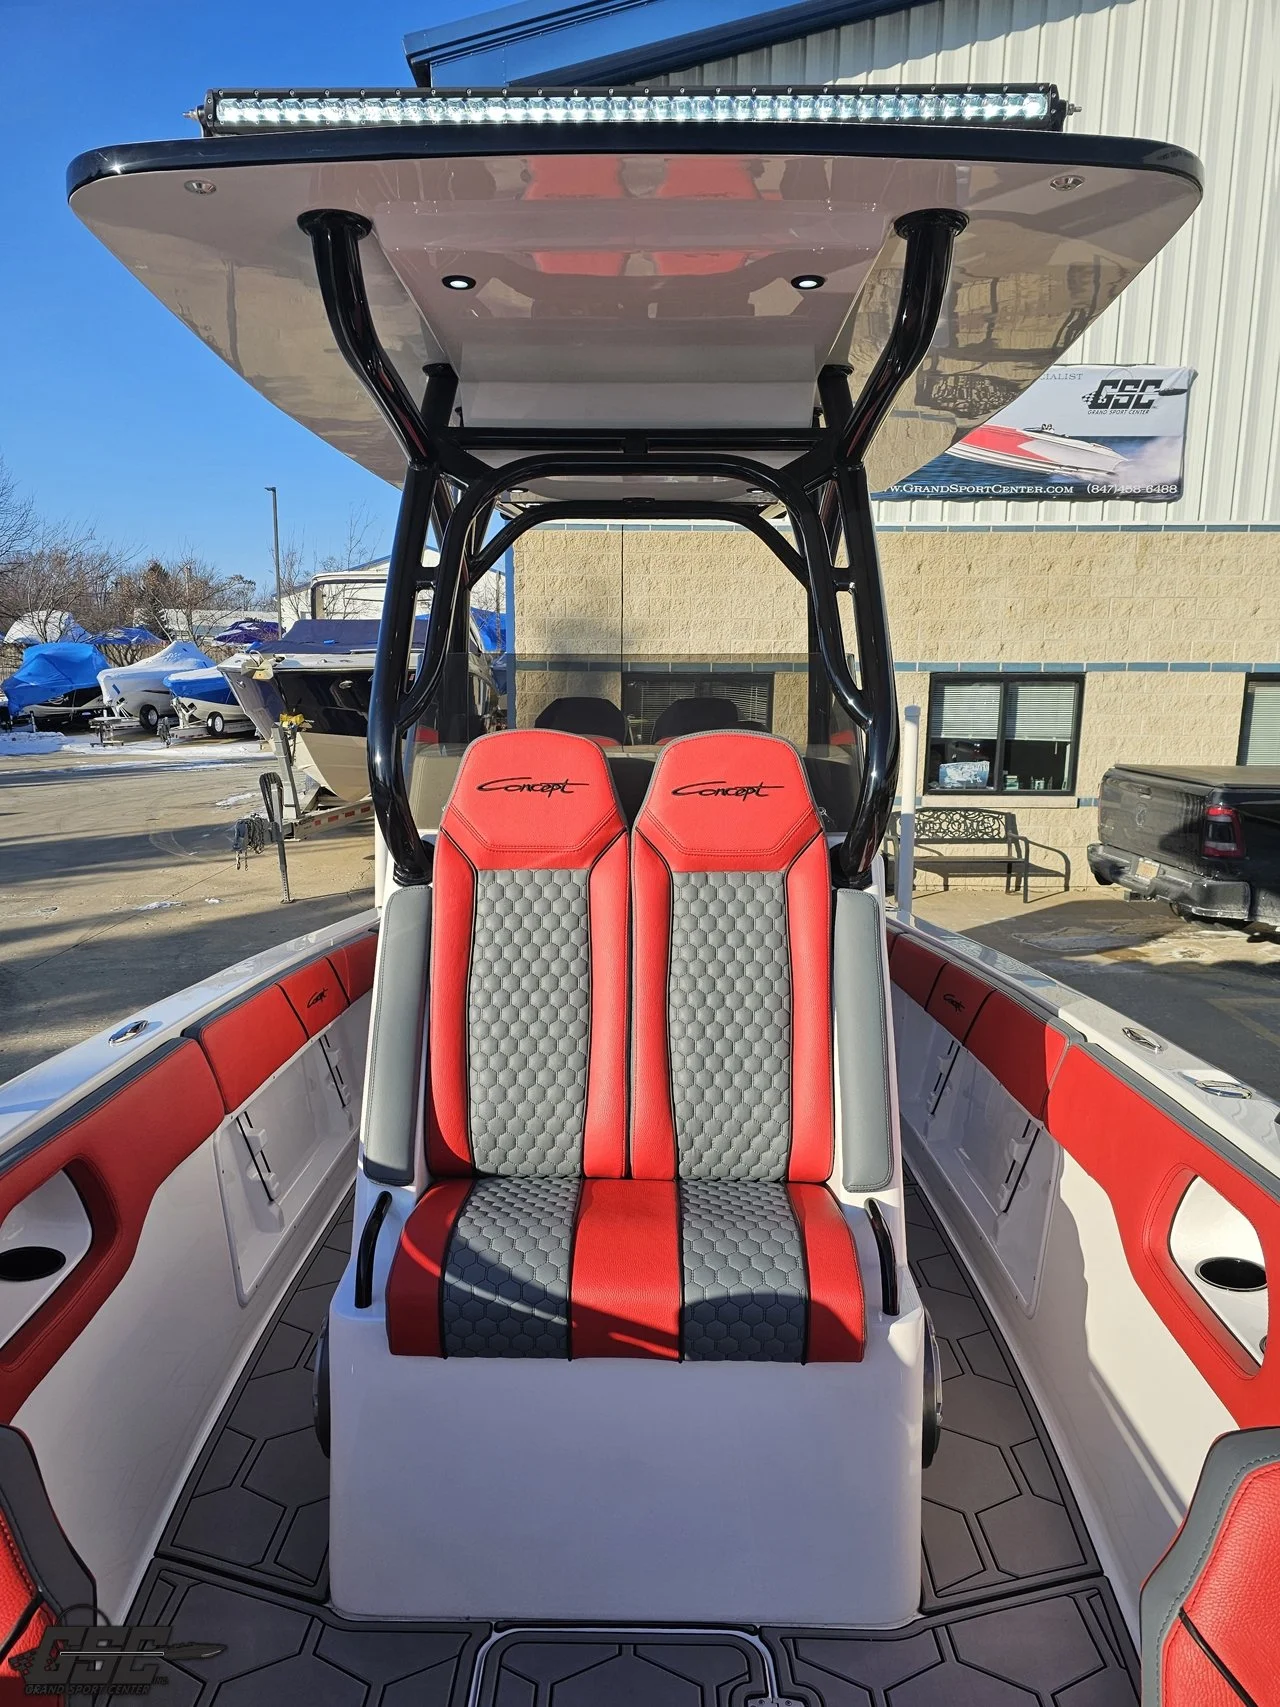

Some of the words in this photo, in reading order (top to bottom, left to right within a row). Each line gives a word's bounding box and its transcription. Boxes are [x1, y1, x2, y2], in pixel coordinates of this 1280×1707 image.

[1087, 379, 1164, 409] GSC
[476, 776, 590, 798] Concept
[671, 780, 785, 801] Concept
